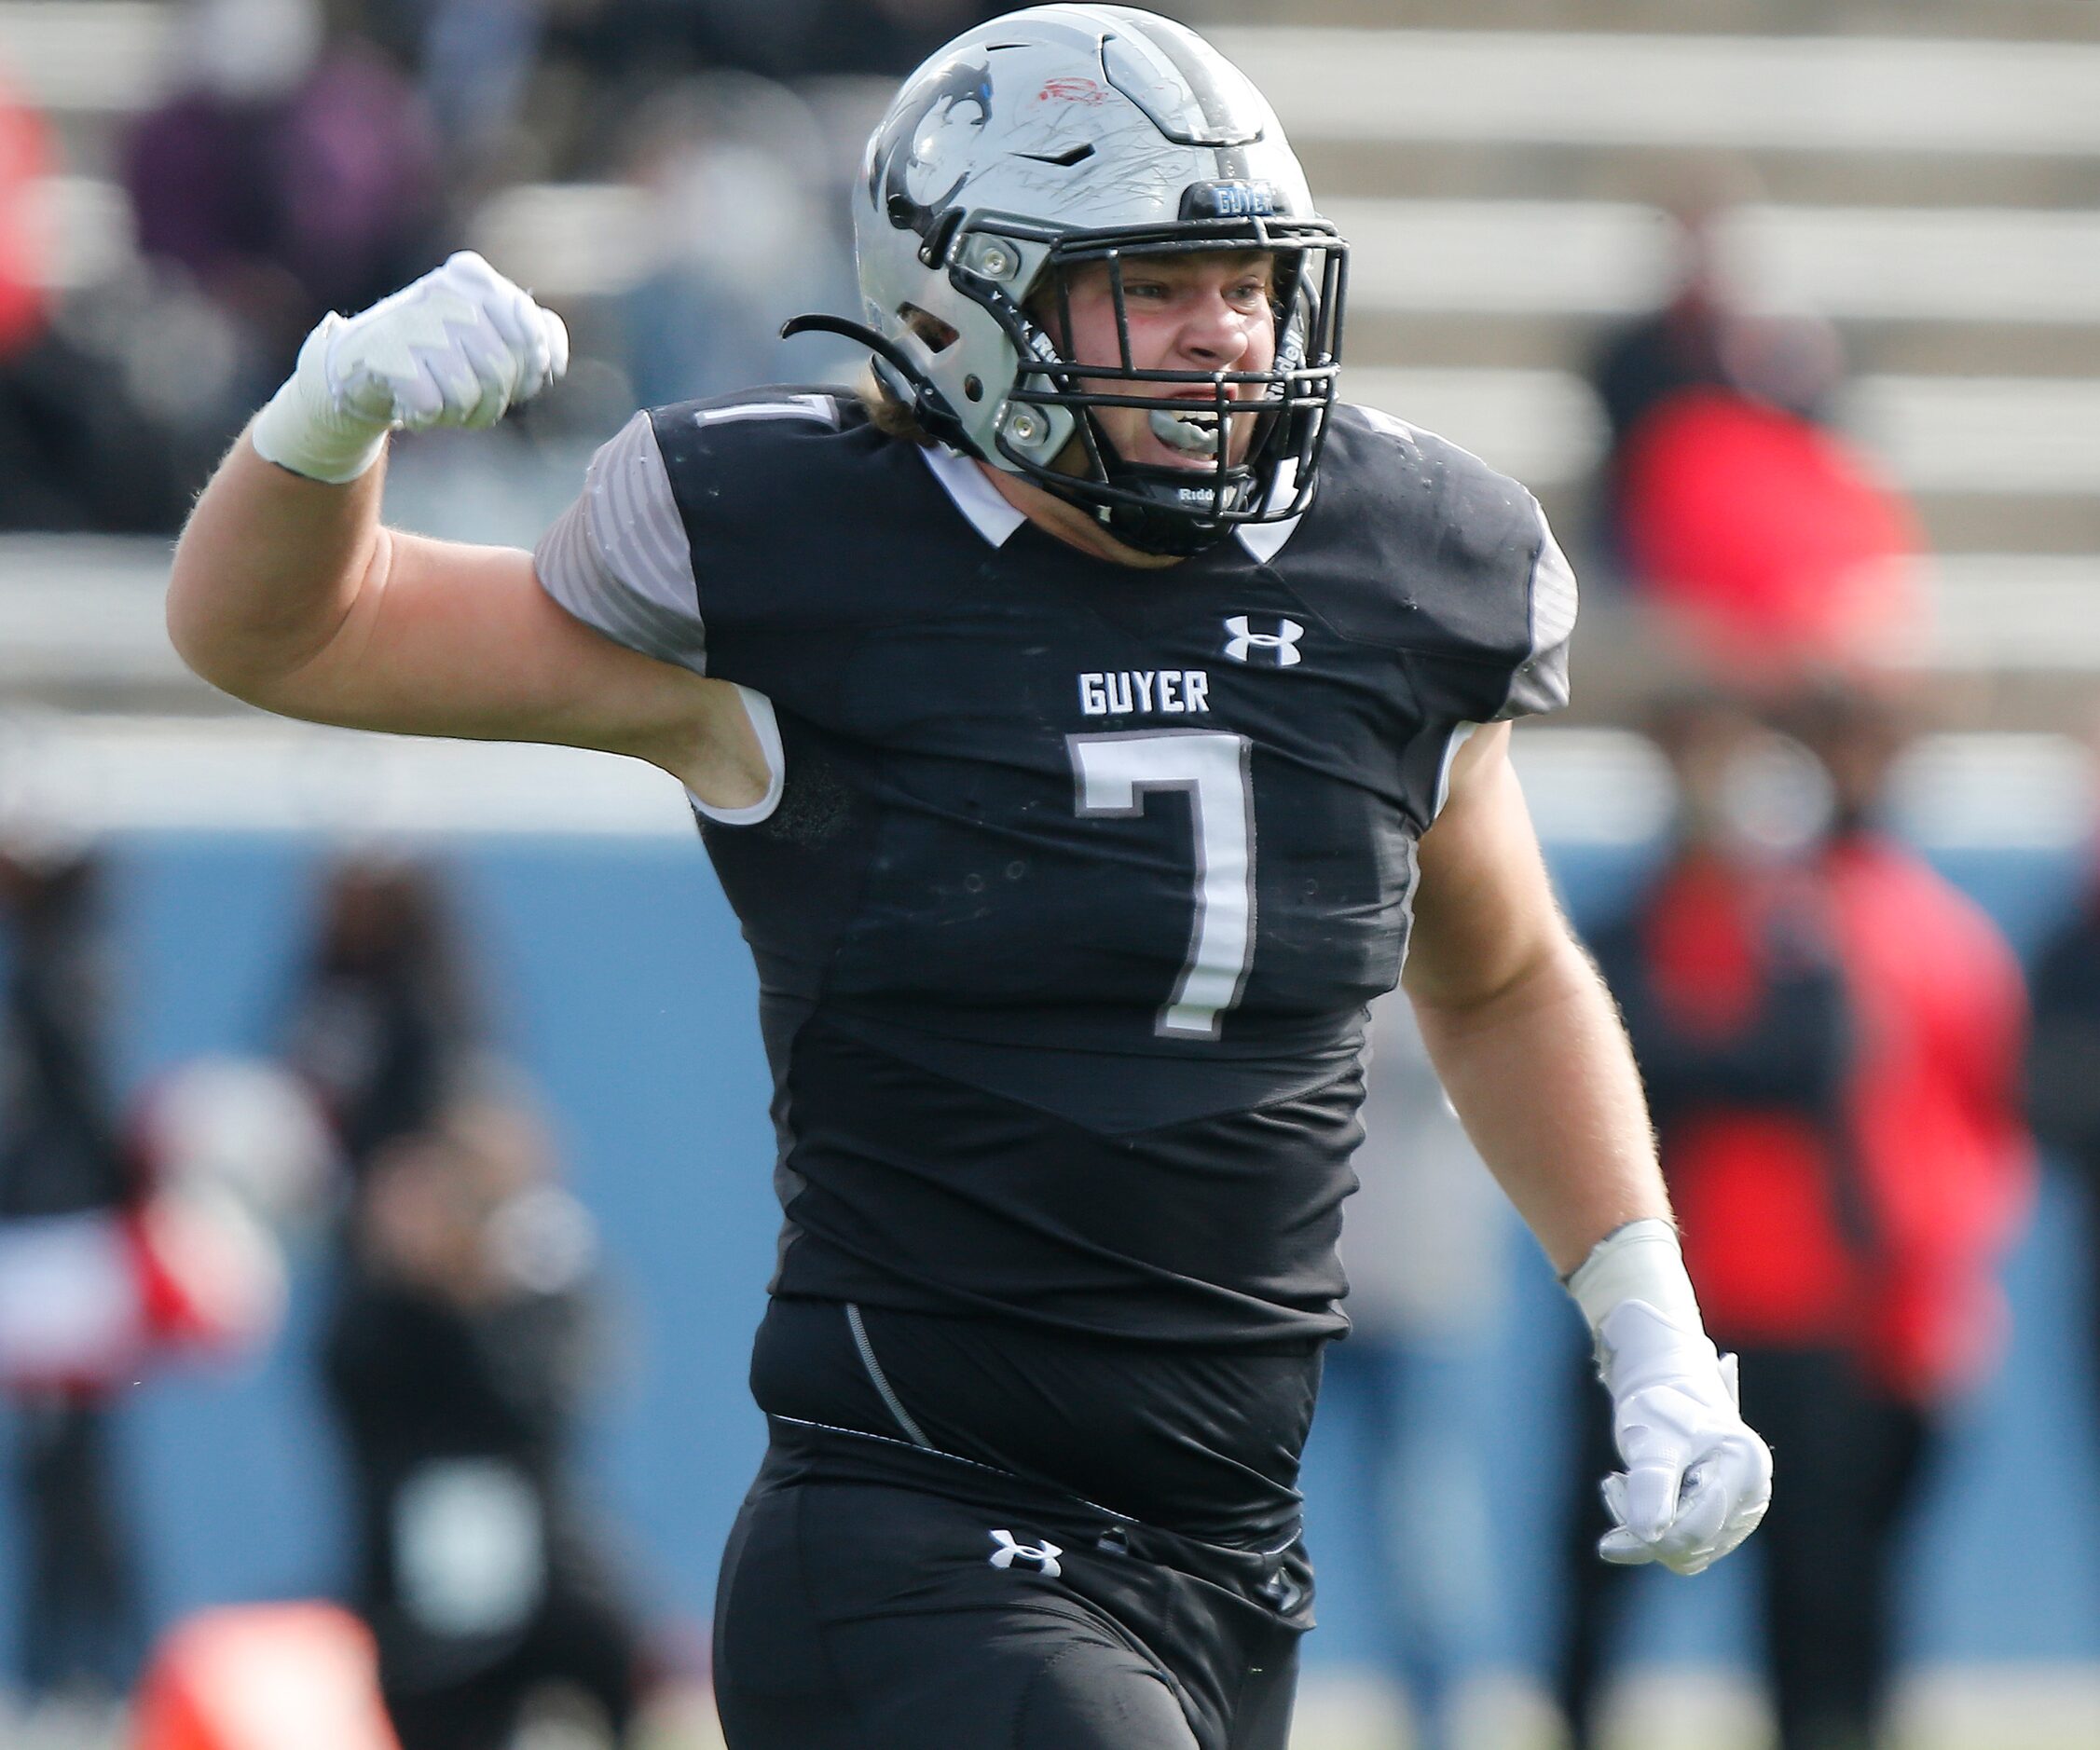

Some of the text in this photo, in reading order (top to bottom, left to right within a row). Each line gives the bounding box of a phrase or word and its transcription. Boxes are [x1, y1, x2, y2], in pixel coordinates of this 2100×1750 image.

[1214, 185, 1273, 215] GUYER
[1078, 670, 1210, 716] GUYER
[1065, 727, 1256, 1042] 7
